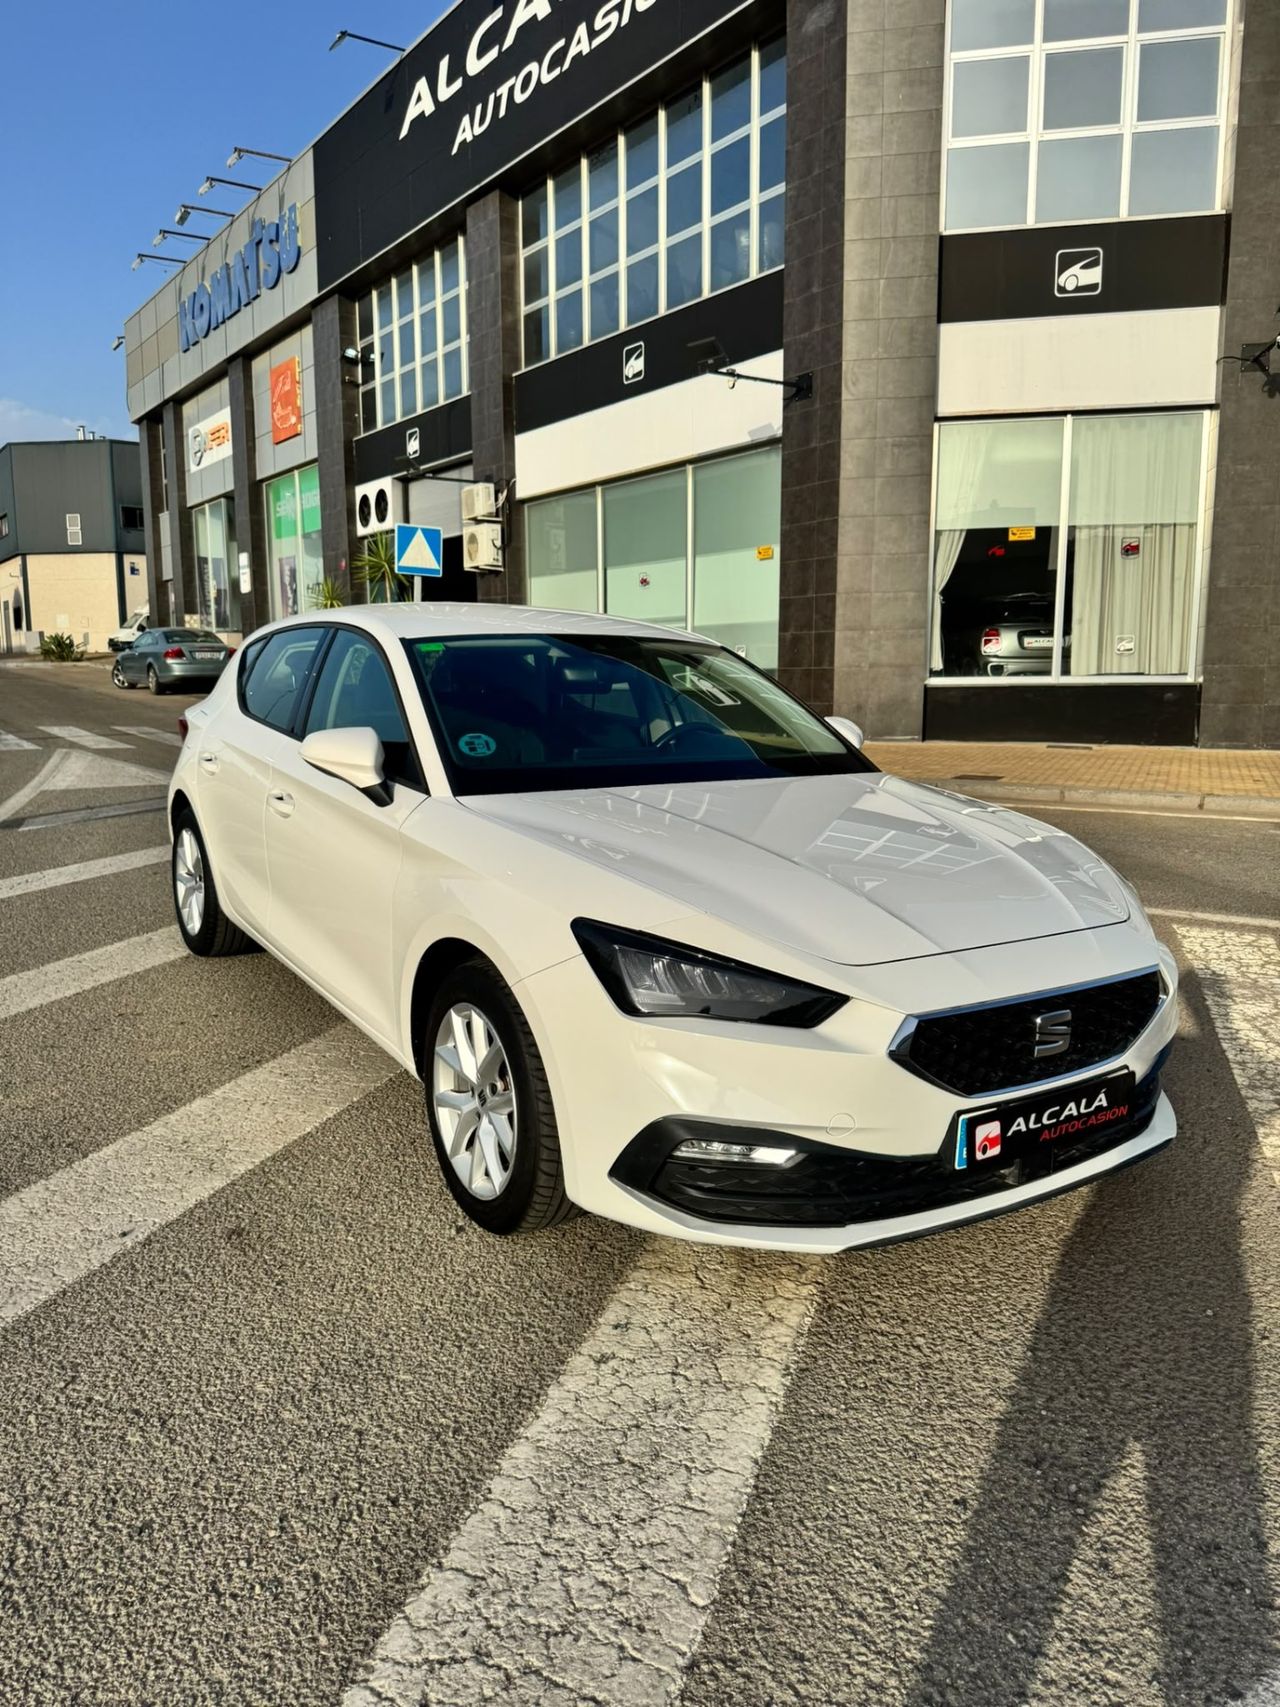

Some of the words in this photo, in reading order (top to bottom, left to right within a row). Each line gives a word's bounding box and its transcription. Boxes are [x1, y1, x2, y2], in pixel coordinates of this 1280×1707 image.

[399, 0, 563, 140] ALCA
[180, 203, 300, 352] KOMATSU
[1006, 1088, 1108, 1137] ALCALÁ
[1039, 1105, 1129, 1142] AUTOCASIÓN
